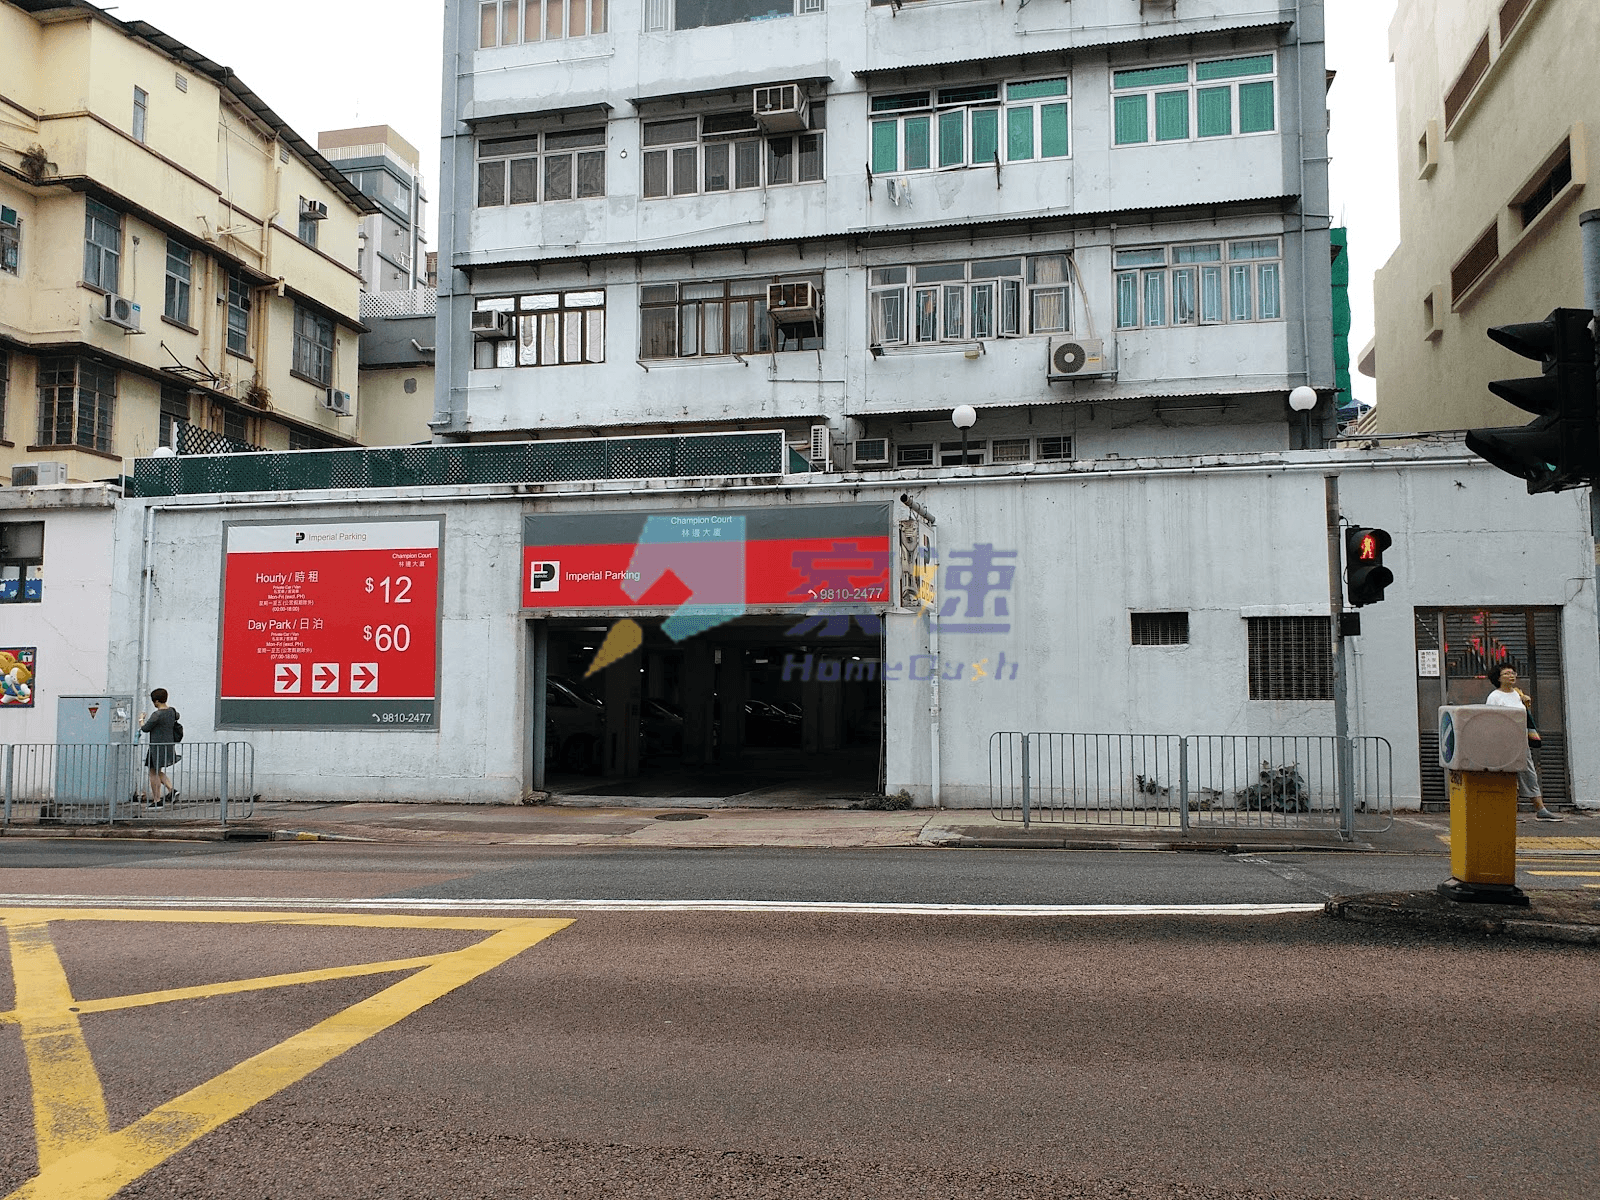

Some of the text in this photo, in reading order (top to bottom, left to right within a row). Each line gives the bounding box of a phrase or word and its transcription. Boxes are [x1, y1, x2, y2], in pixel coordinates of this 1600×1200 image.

[670, 516, 732, 525] Champion Court
[308, 534, 338, 542] Imperial
[339, 532, 367, 541] Parking
[256, 572, 287, 585] Hourly
[566, 571, 602, 582] Imperial
[605, 570, 640, 582] Parking
[365, 576, 412, 603] $12
[820, 588, 883, 600] 9810-2477
[248, 619, 267, 632] Day
[269, 619, 291, 630] Park
[300, 618, 323, 630] 日泊
[363, 624, 410, 651] $60
[382, 713, 431, 723] 9810-2477
